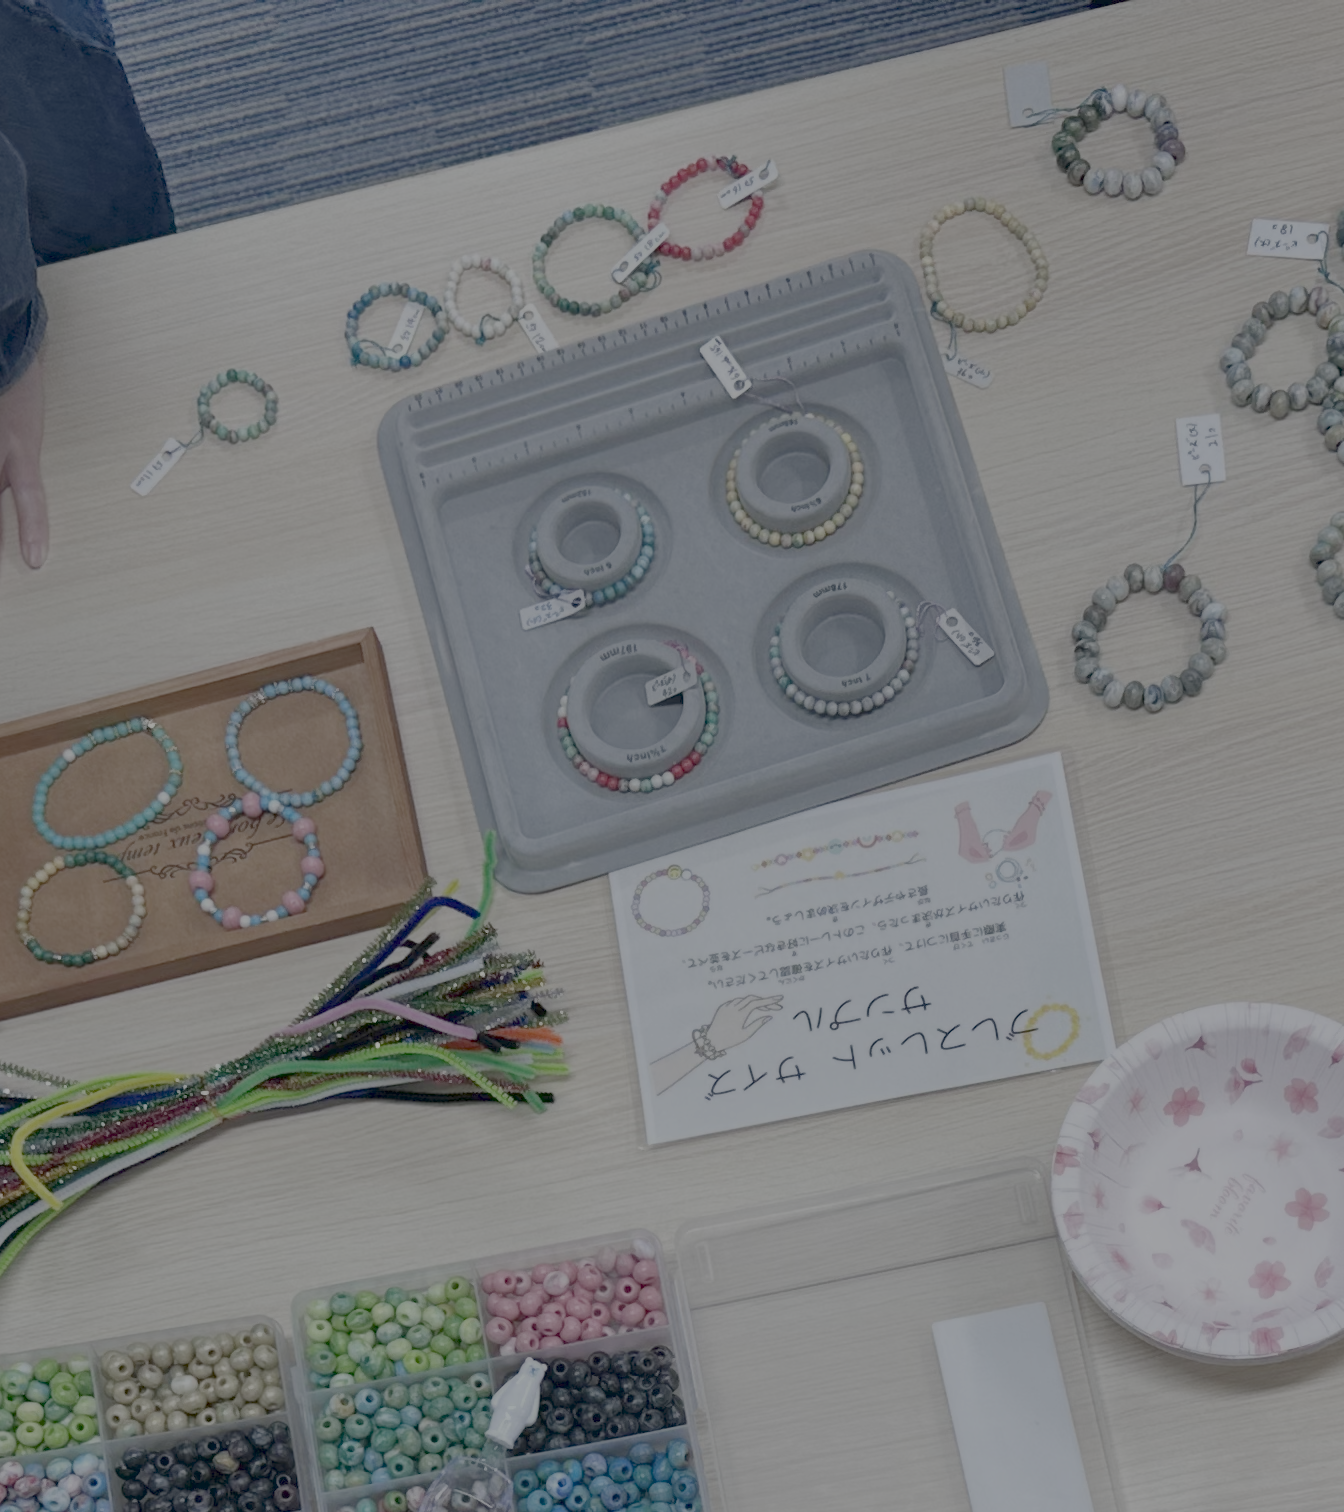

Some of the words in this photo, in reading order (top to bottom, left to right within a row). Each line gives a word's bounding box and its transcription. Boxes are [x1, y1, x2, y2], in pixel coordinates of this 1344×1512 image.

[767, 885, 928, 925] 長さやデザインを決めましょう。
[793, 986, 931, 1031] サンプル
[833, 1009, 1038, 1069] ブレスレット
[705, 1056, 806, 1100] サイズ
[1211, 1177, 1243, 1218] bloom
[1225, 1173, 1266, 1235] favorite
